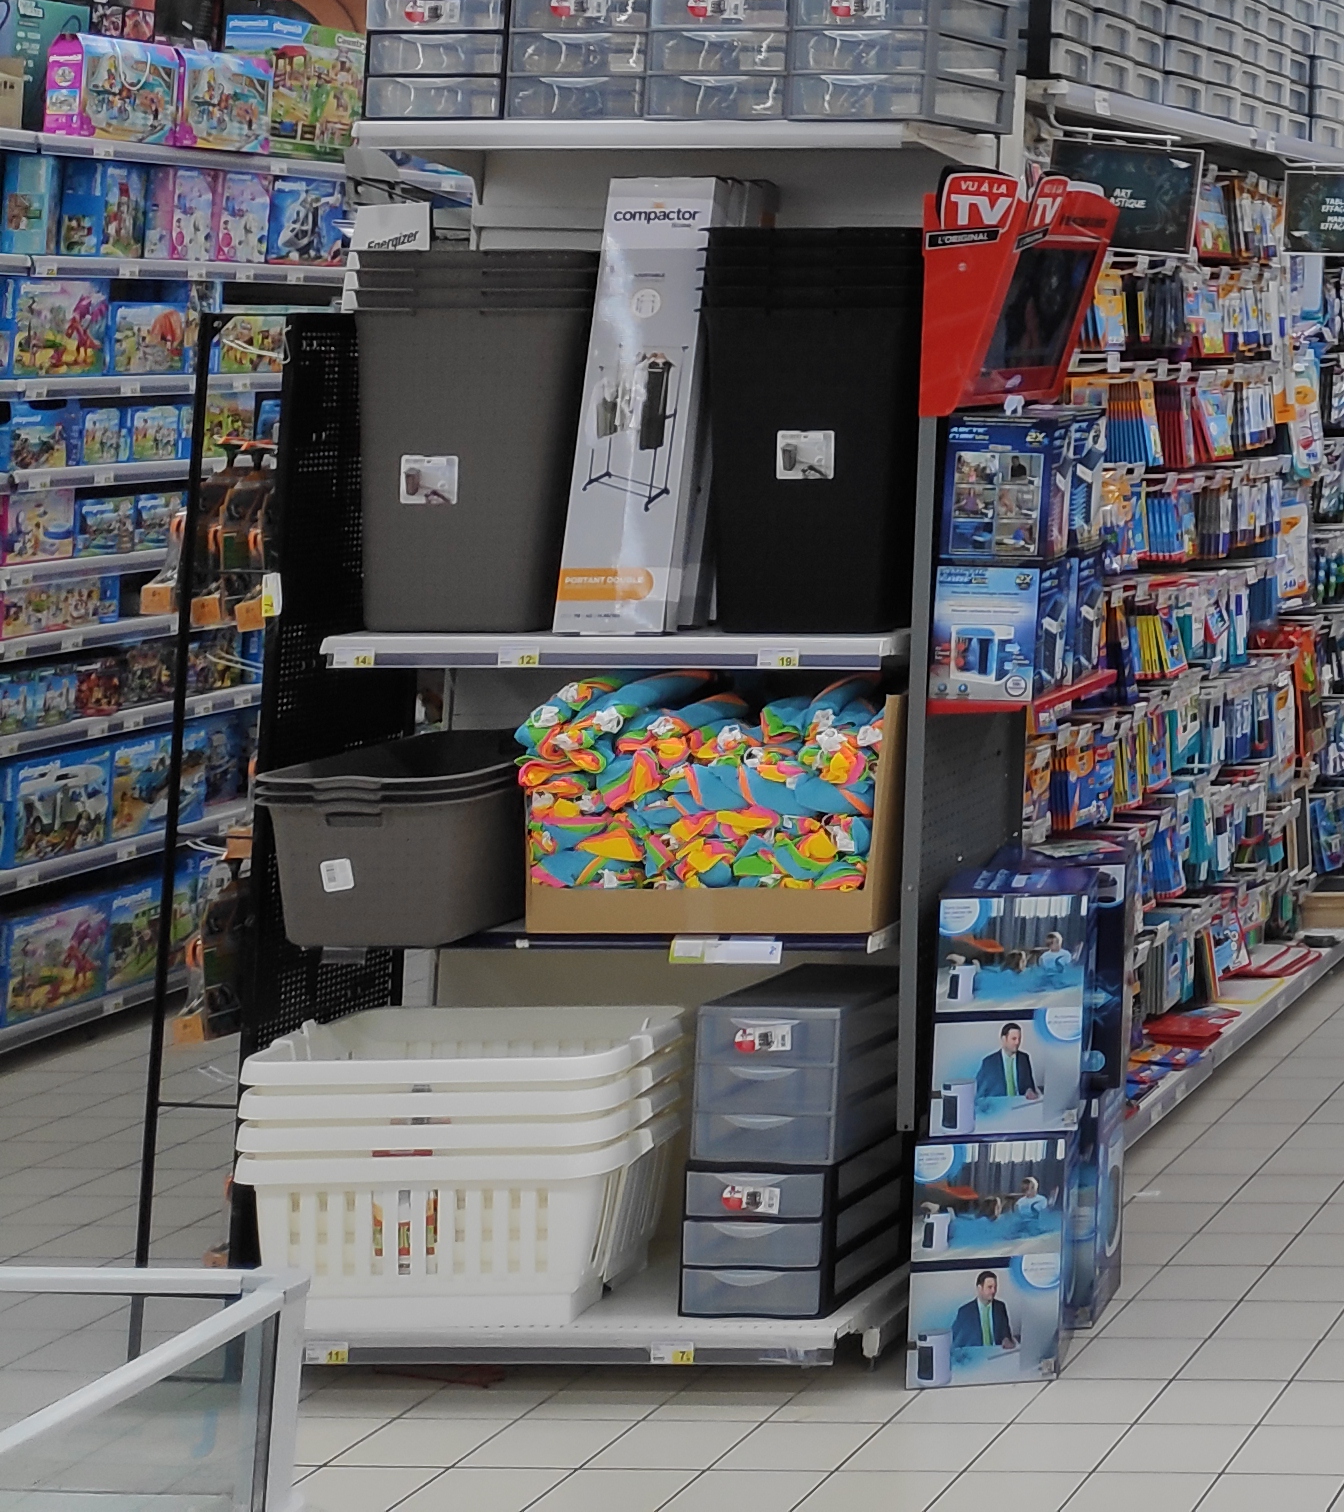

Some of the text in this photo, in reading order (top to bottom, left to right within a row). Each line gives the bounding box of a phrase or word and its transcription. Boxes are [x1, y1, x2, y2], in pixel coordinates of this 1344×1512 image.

[960, 180, 979, 192] VU
[992, 183, 1008, 194] LA
[1113, 188, 1133, 198] ART
[951, 194, 1012, 226] TV
[1109, 197, 1147, 209] ASTIQUE
[613, 207, 700, 225] compactor
